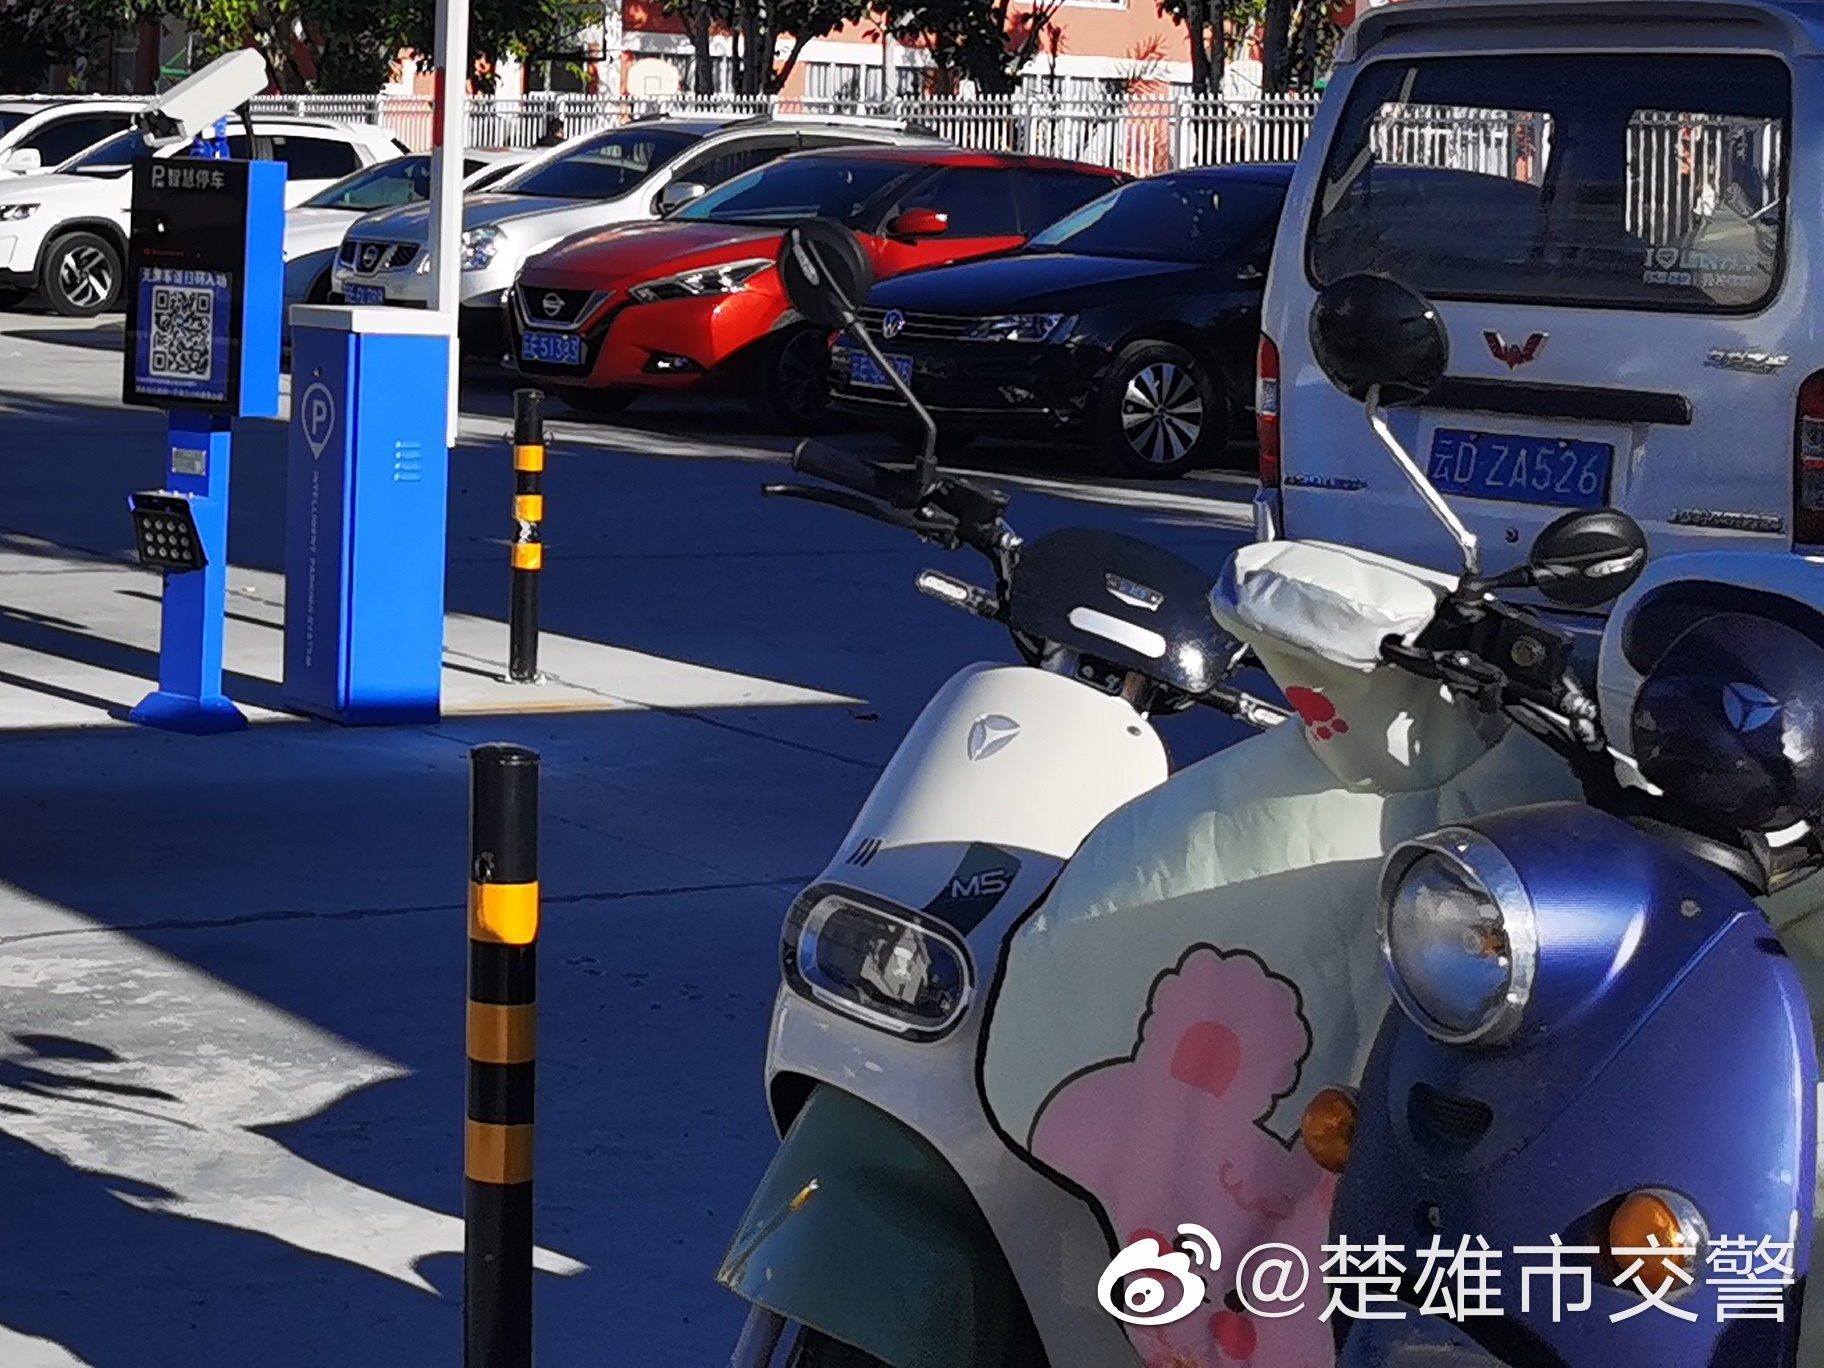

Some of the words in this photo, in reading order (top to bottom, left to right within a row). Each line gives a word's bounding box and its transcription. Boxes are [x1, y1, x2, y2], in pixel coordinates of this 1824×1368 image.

[168, 167, 226, 189] 智慧停车
[311, 399, 327, 435] P
[952, 870, 1007, 898] M5
